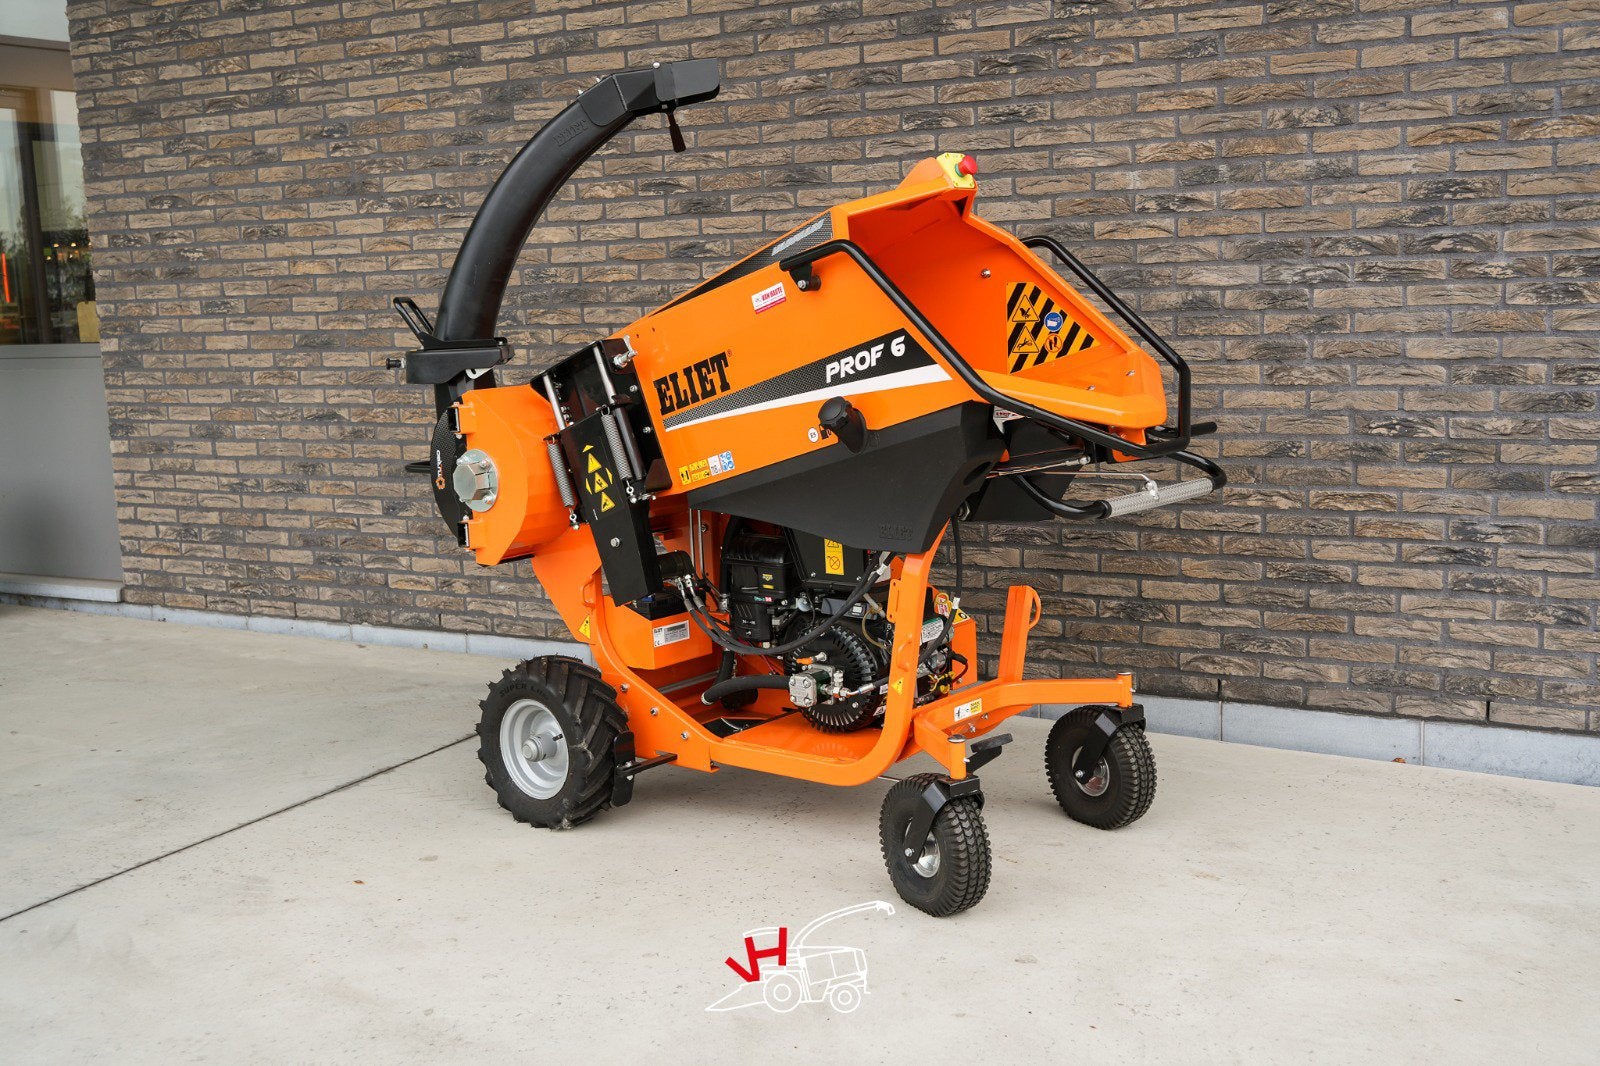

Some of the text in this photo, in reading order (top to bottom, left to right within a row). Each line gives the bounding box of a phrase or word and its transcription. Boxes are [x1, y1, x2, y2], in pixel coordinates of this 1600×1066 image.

[653, 351, 732, 416] ELIET
[825, 335, 906, 384] PROF 6
[499, 682, 528, 698] SUPER
